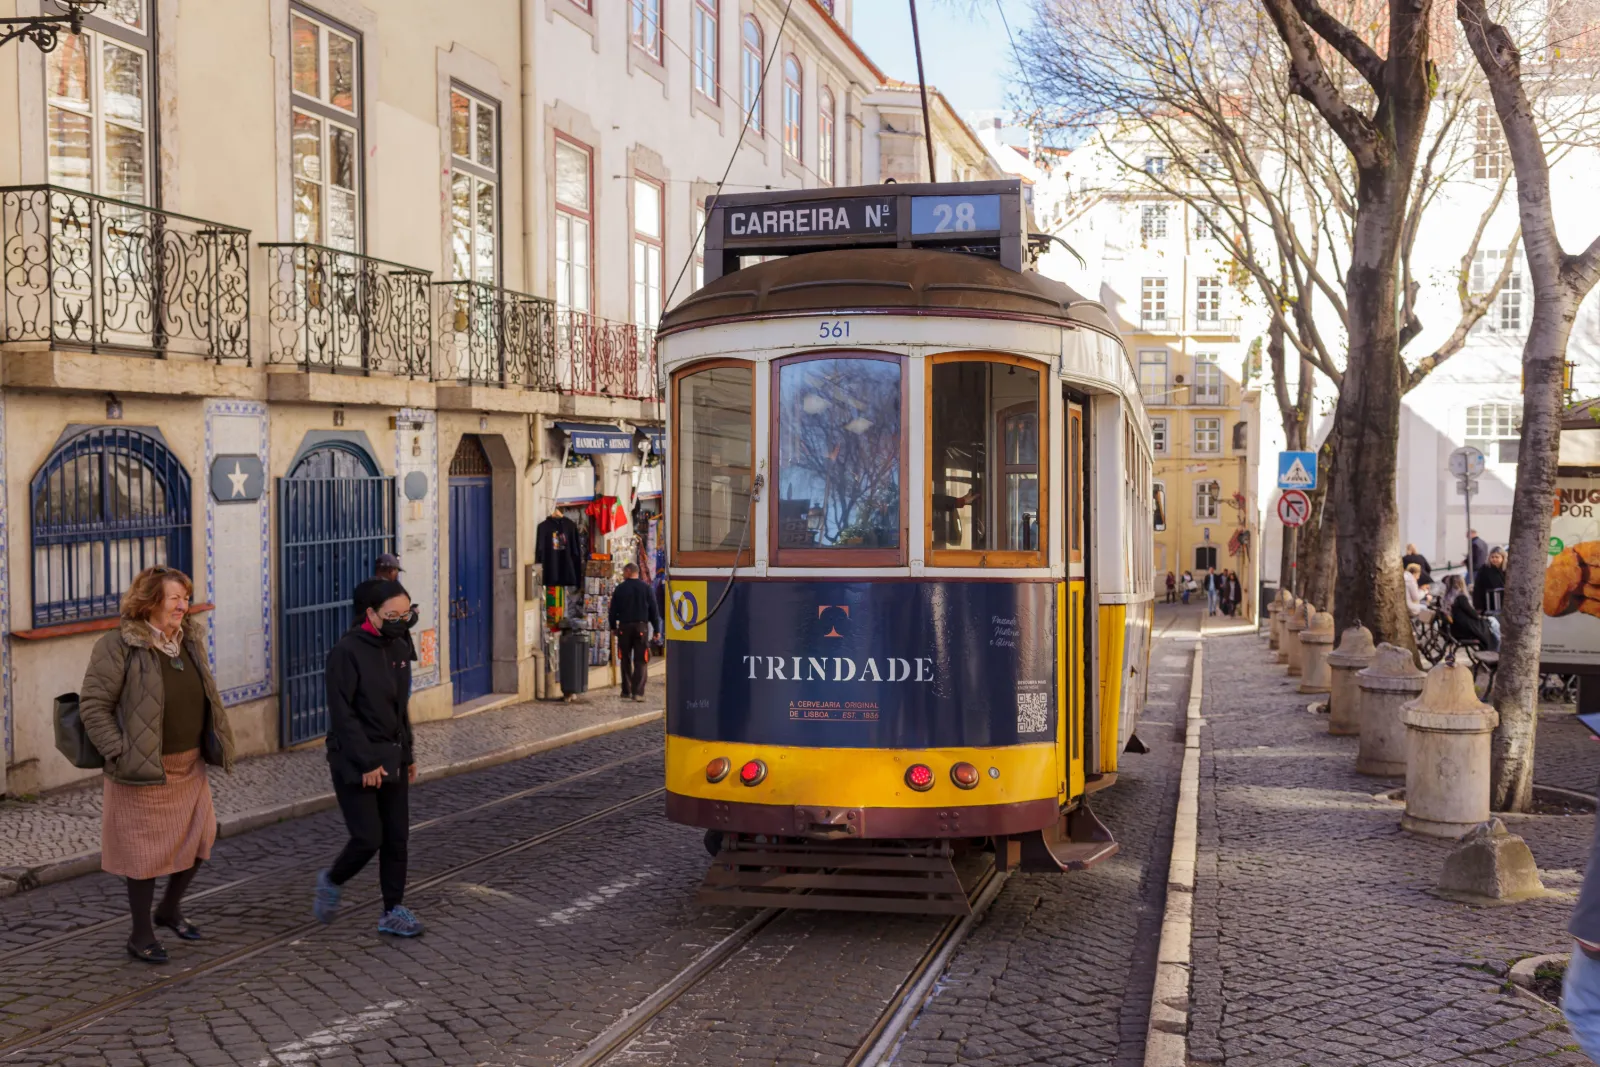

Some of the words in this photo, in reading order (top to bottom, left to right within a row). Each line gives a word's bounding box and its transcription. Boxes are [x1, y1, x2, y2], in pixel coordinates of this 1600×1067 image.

[731, 206, 850, 235] CARREIRA
[932, 202, 976, 233] 28
[819, 321, 850, 338] 561
[1559, 504, 1594, 518] POR
[743, 655, 934, 682] TRINDADE
[789, 700, 795, 708] A
[797, 700, 841, 709] CERVEJARIA
[844, 701, 879, 709] ORIGINAL
[789, 710, 799, 718] DE
[803, 710, 829, 718] LISBOA
